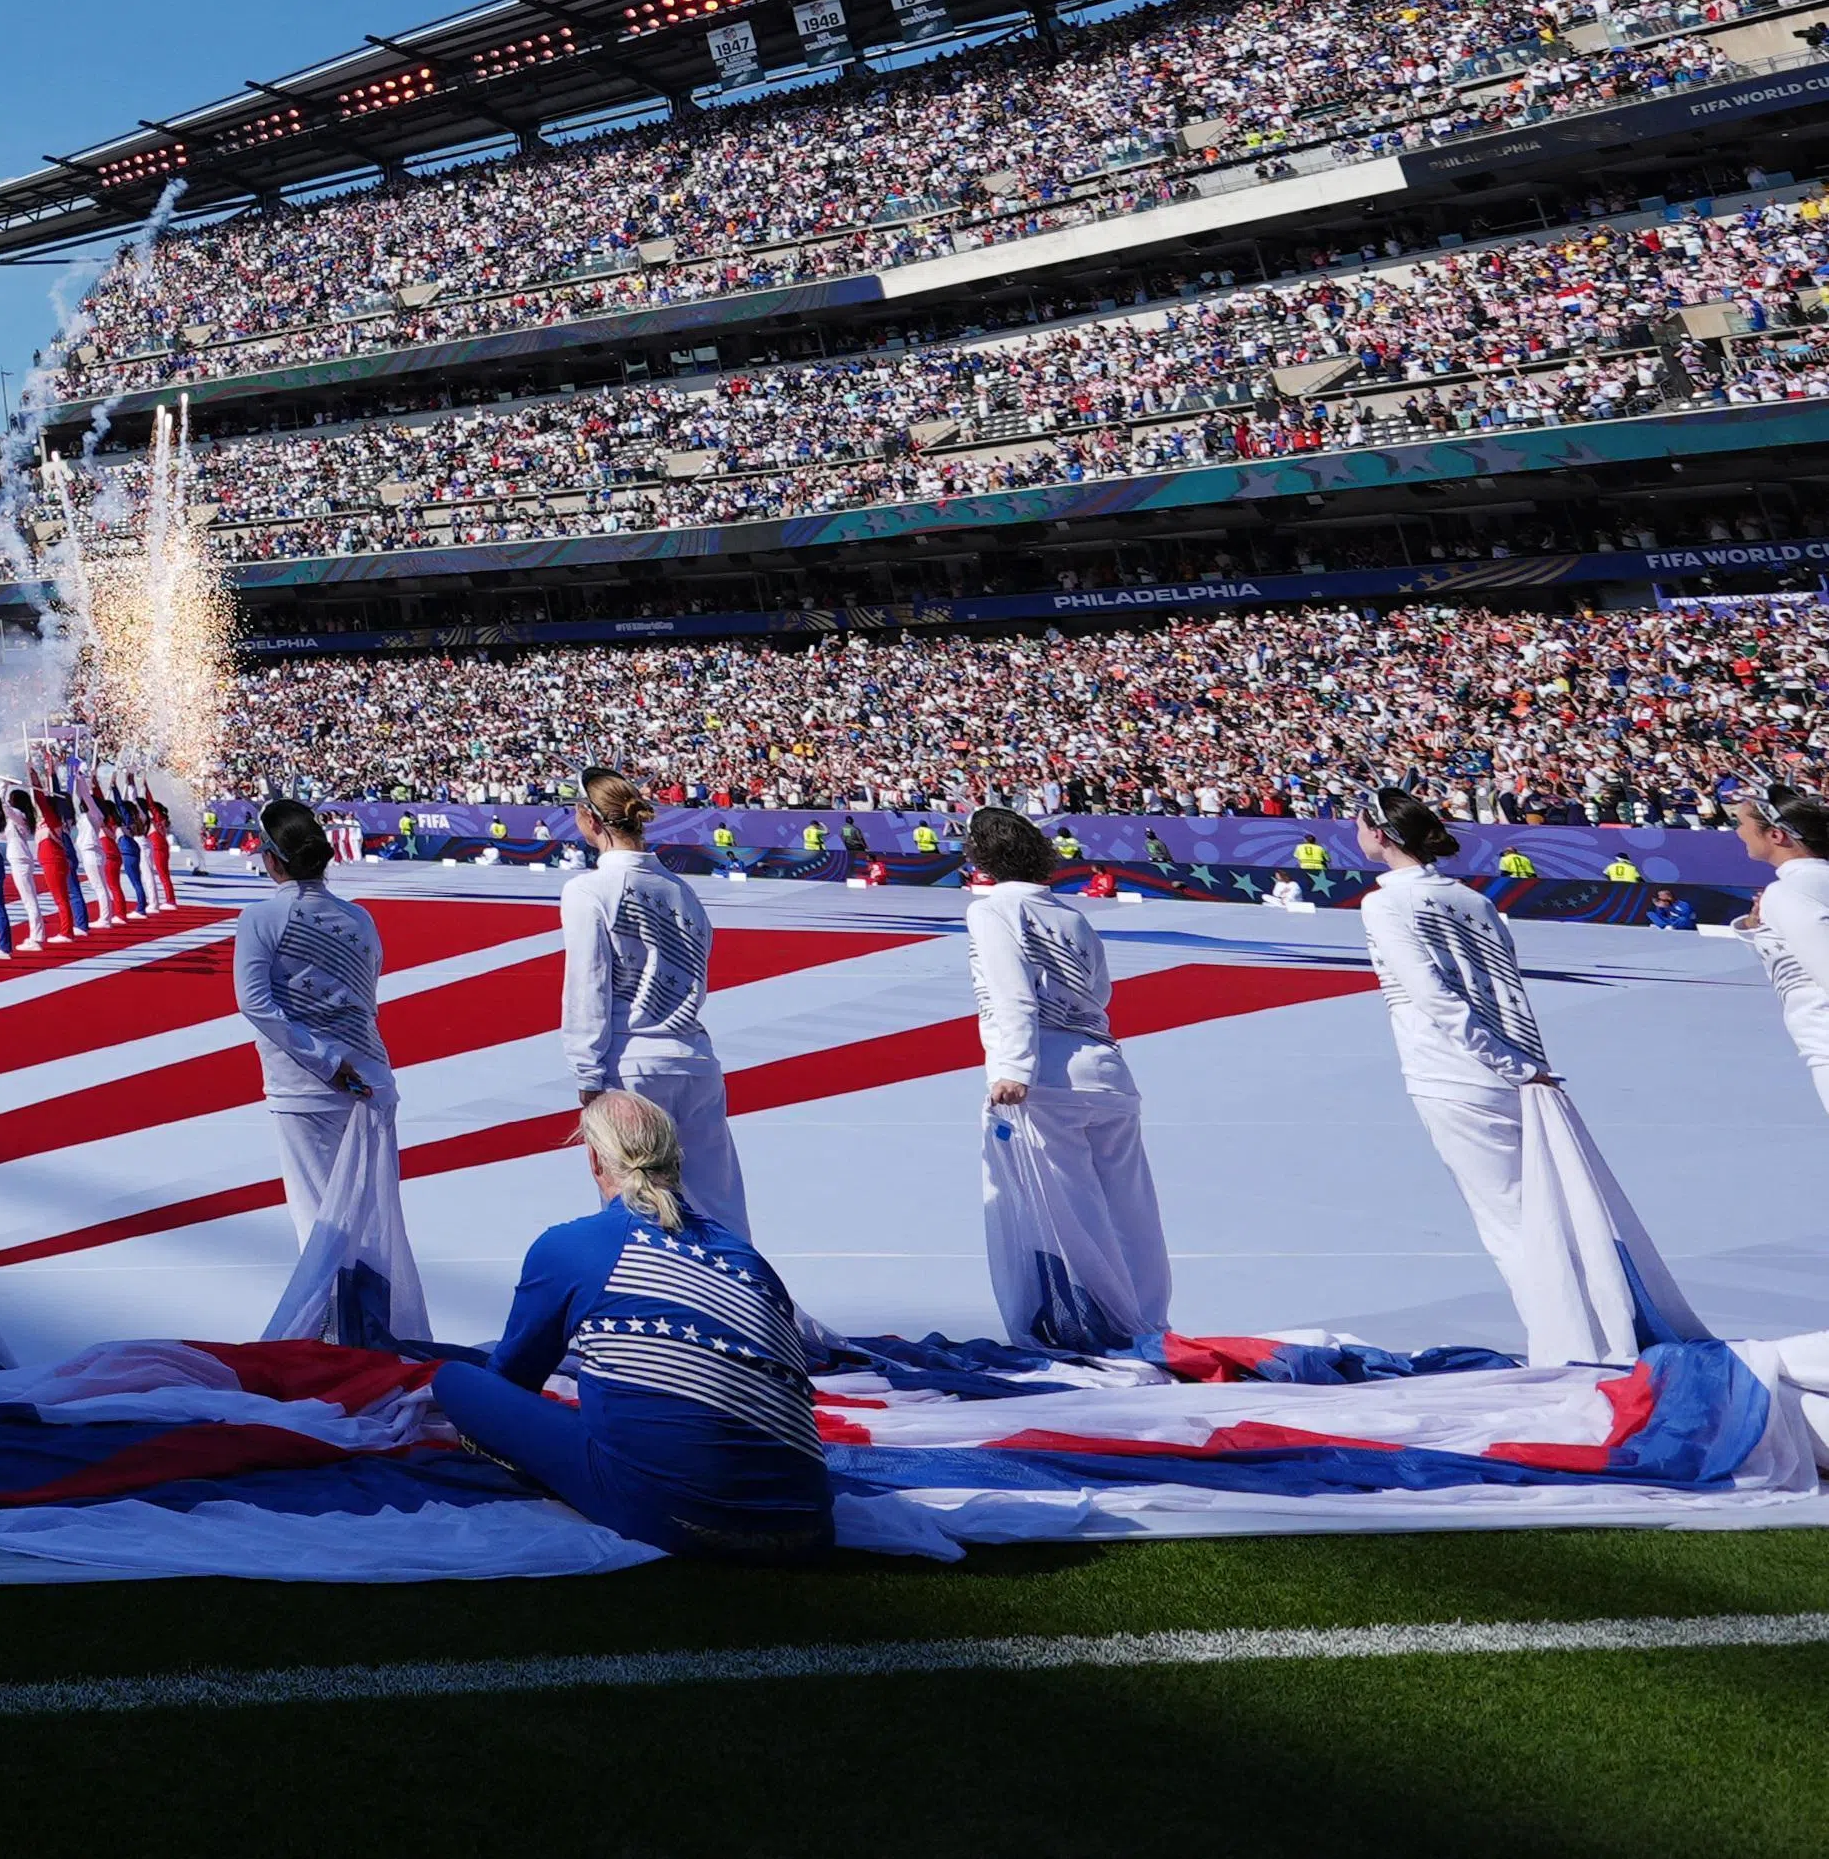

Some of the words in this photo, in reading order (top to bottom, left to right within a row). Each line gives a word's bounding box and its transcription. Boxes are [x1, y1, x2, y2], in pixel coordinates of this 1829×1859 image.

[802, 12, 840, 34] 1948
[715, 36, 750, 57] 1947
[1690, 95, 1732, 117] FIFA
[1730, 81, 1805, 110] WORLD
[1428, 141, 1542, 172] PHILADELPHIA
[1646, 552, 1702, 570] FIFA
[1702, 545, 1803, 566] WORLD
[1053, 580, 1263, 611] PHILADELPHIA
[1670, 596, 1699, 607] FIFA
[417, 813, 451, 830] FIFA
